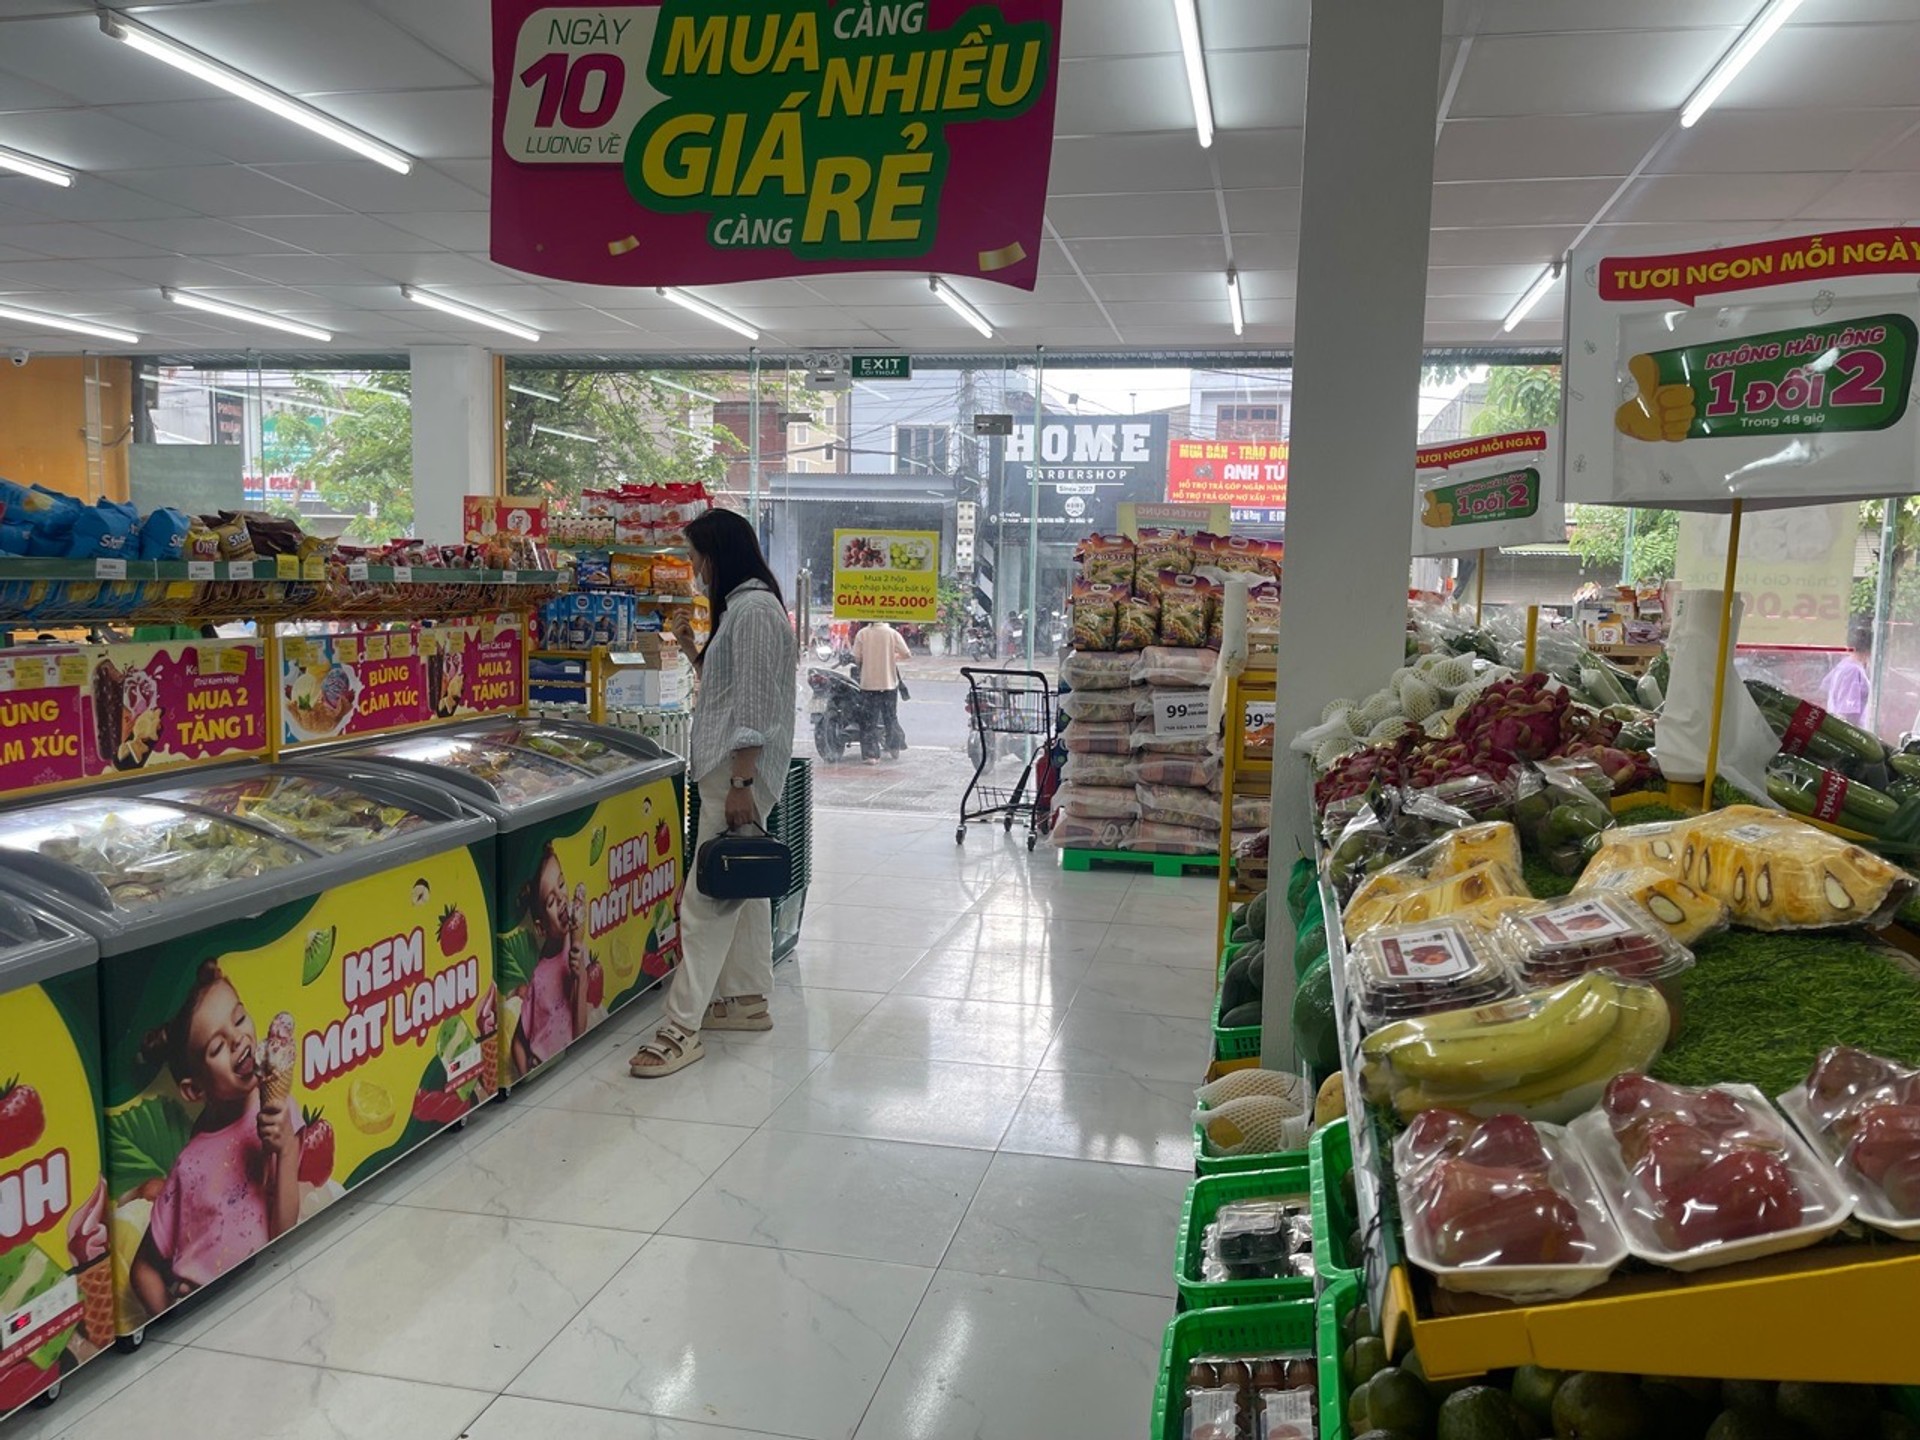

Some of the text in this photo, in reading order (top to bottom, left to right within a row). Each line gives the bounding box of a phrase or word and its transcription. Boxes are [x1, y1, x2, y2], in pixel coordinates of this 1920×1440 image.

[548, 17, 631, 46] NGÀY
[662, 1, 924, 76] MUA CÀNG
[817, 24, 1041, 118] NHIỀU
[519, 53, 626, 129] 10
[525, 131, 623, 155] LƯƠNG VỀ
[641, 92, 810, 198] GIÁ
[801, 122, 934, 244] RẺ
[713, 217, 793, 246] CÀNG
[1614, 236, 1920, 291] TƯƠI NGON MỖI NGÀY
[1706, 326, 1887, 371] KHÔNG HÀI LÒNG
[861, 359, 901, 370] EXIT
[1706, 350, 1888, 417] 1 ĐỔI 2
[1740, 412, 1826, 429] Trong 48 giờ
[1004, 424, 1151, 462] HOME
[1180, 444, 1203, 459] MUA
[1206, 443, 1228, 459] BÁN
[1239, 446, 1267, 460] TRAO
[1444, 447, 1479, 461] NGON
[1481, 438, 1504, 453] MỖI
[1505, 436, 1542, 449] NGÀY
[1026, 469, 1127, 480] BARBERSHOP
[1192, 481, 1208, 490] TRỢ
[1225, 481, 1241, 490] GÓP
[1224, 461, 1286, 480] ANH TÚ
[1186, 491, 1201, 500] TRỢ
[1218, 491, 1235, 500] GÓP
[1457, 494, 1471, 516] 1
[1506, 483, 1529, 509] 2
[837, 591, 876, 606] GIẢM
[368, 663, 410, 687] BÙNG
[478, 660, 512, 677] MUA 2
[187, 687, 249, 713] MUA 2
[360, 684, 420, 717] CẢM XÚC
[472, 679, 508, 705] TẶNG
[509, 681, 514, 697] 1
[1166, 704, 1187, 718] 99
[31, 728, 79, 760] XÚC
[177, 714, 255, 751] TẶNG 1
[609, 834, 648, 881] KEM
[590, 859, 675, 935] MÁT LẠNH
[344, 929, 423, 1003] KEM
[304, 958, 478, 1084] MÁT LẠNH
